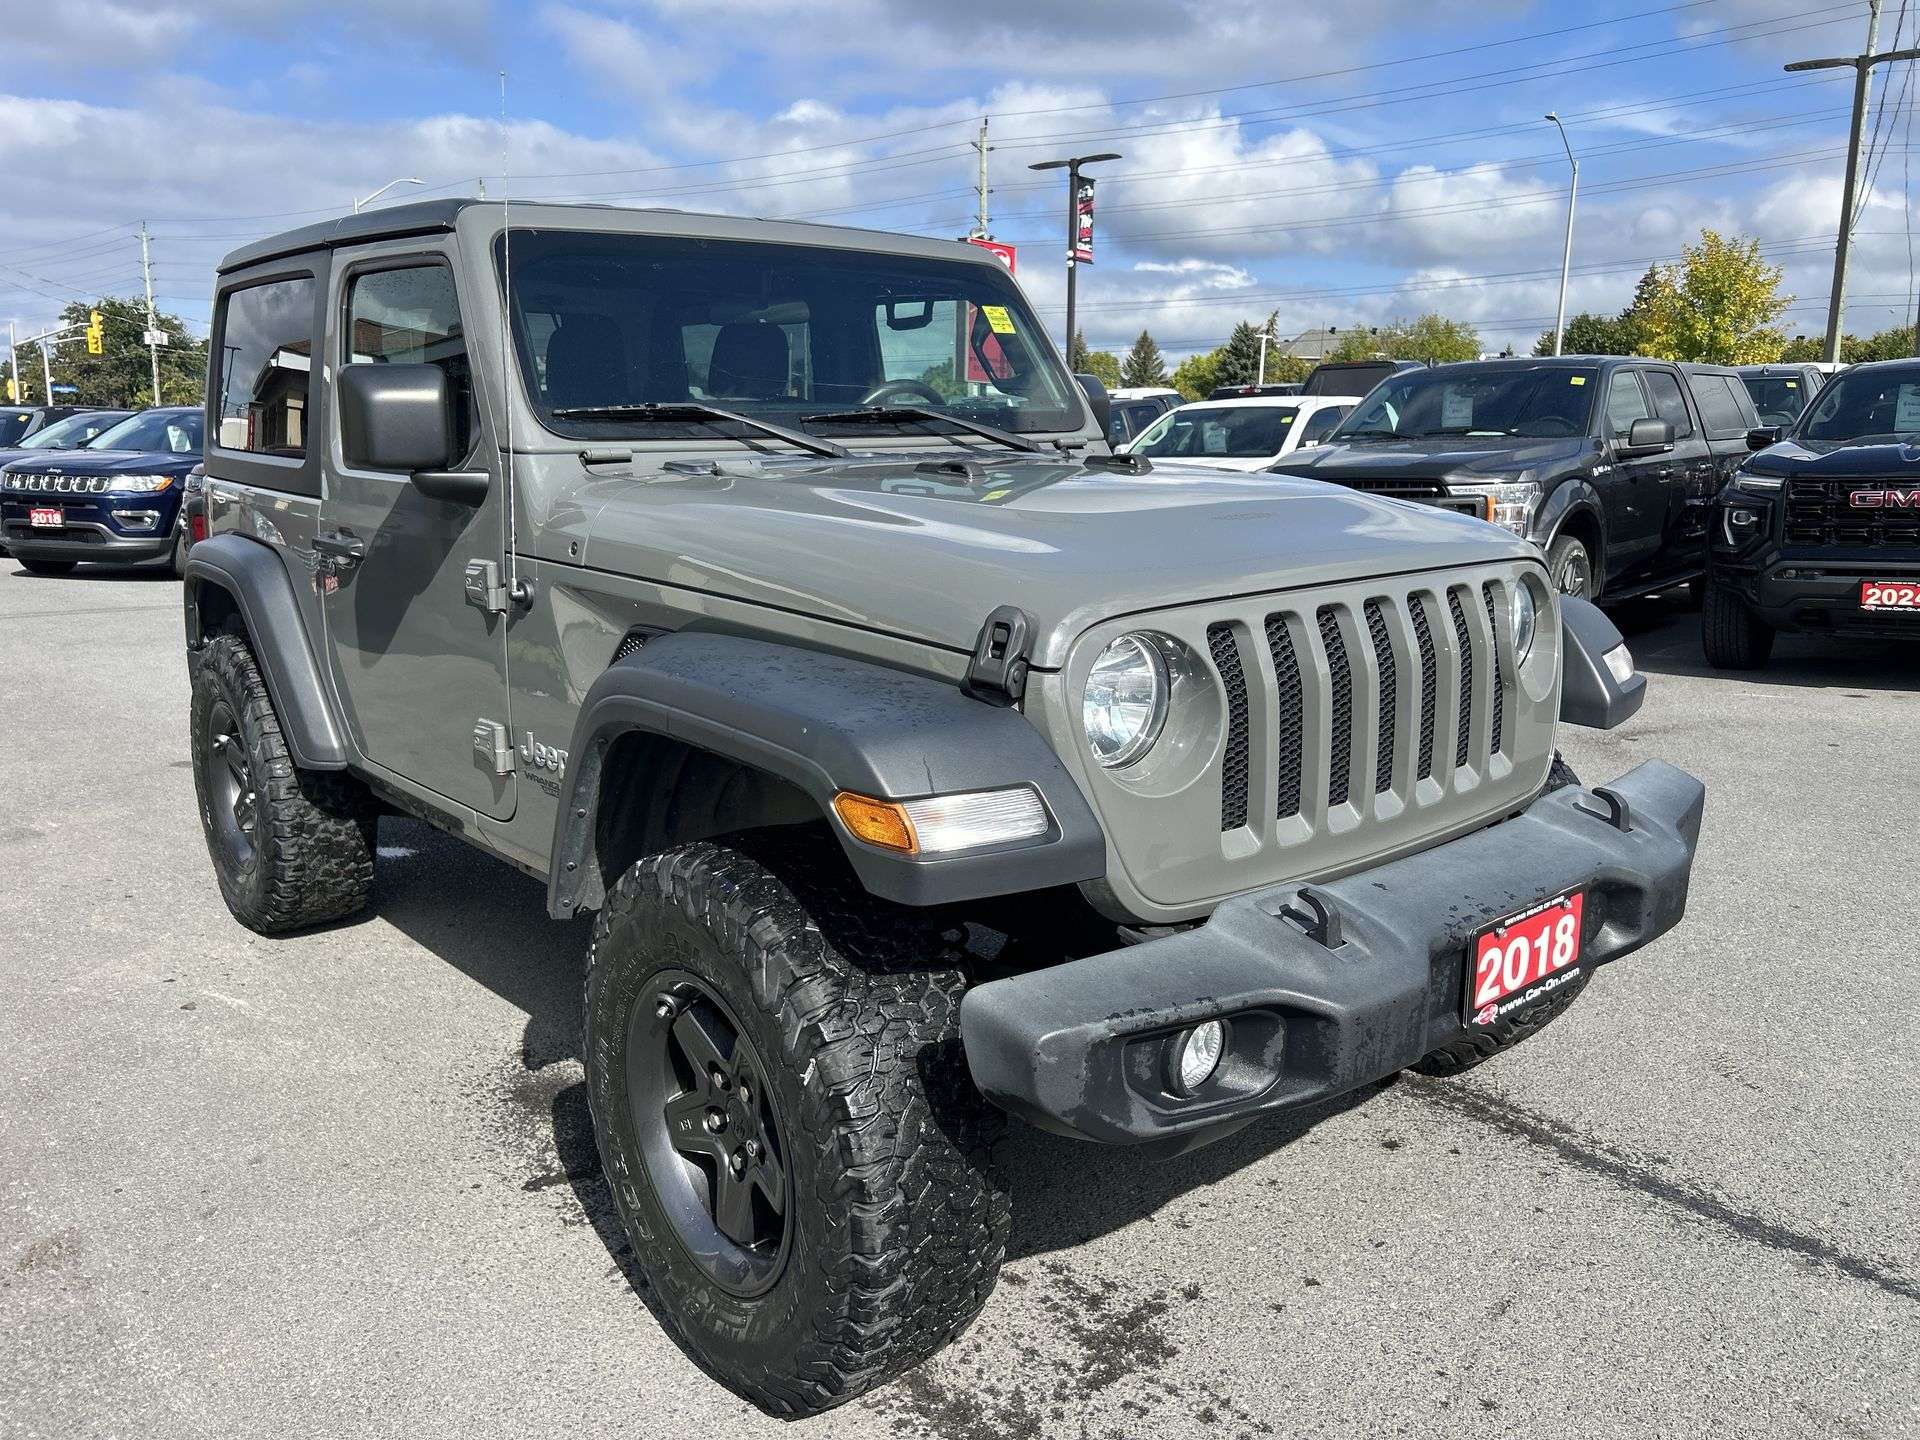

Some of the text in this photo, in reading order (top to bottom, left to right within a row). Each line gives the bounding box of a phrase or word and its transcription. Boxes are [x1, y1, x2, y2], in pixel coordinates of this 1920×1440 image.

[31, 513, 62, 523] 2018
[1475, 913, 1576, 1008] 2018
[1499, 967, 1580, 1015] www.Car-On.com
